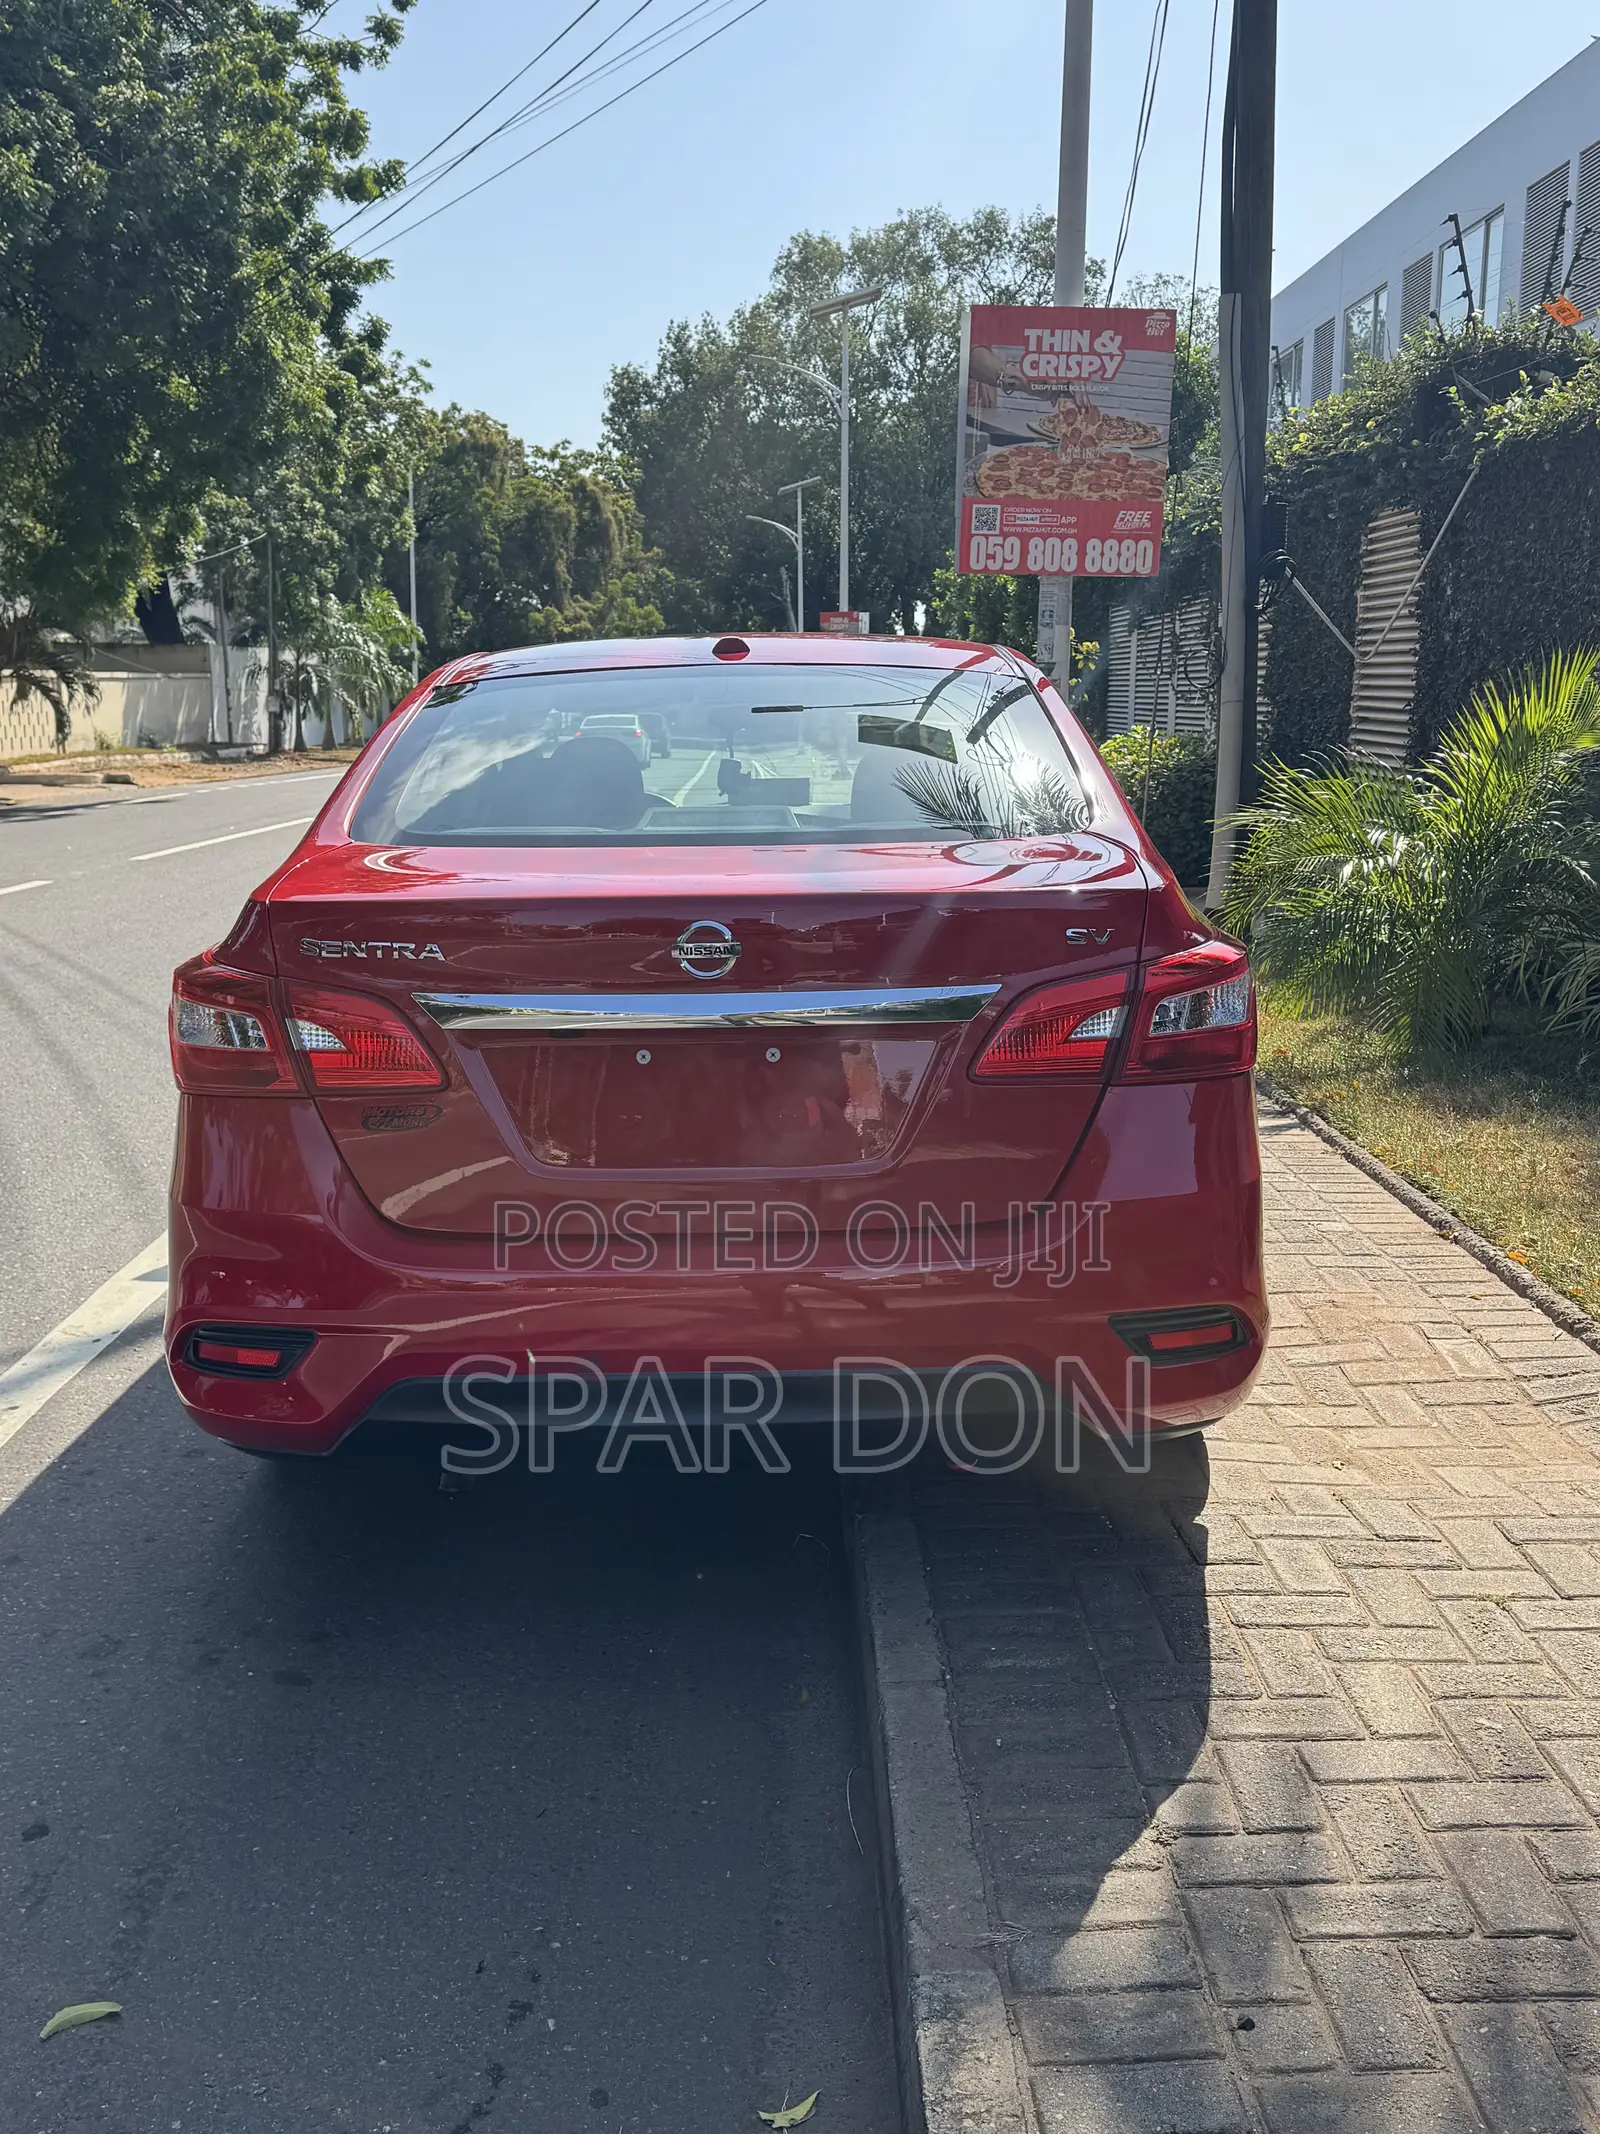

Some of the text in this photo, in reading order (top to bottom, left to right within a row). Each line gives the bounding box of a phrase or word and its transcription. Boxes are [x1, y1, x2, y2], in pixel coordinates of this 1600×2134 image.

[1145, 319, 1170, 330] Pizza
[1147, 327, 1165, 336] Hut
[1024, 328, 1122, 355] THIN &
[1022, 353, 1122, 378] CRISPY
[1060, 516, 1077, 524] APP
[1117, 511, 1152, 522] FREE
[969, 536, 1154, 574] 059 808 8880
[1065, 928, 1115, 945] SV
[300, 938, 446, 961] SENTRA
[679, 946, 733, 956] NISSAN
[362, 1105, 426, 1118] MOTORS
